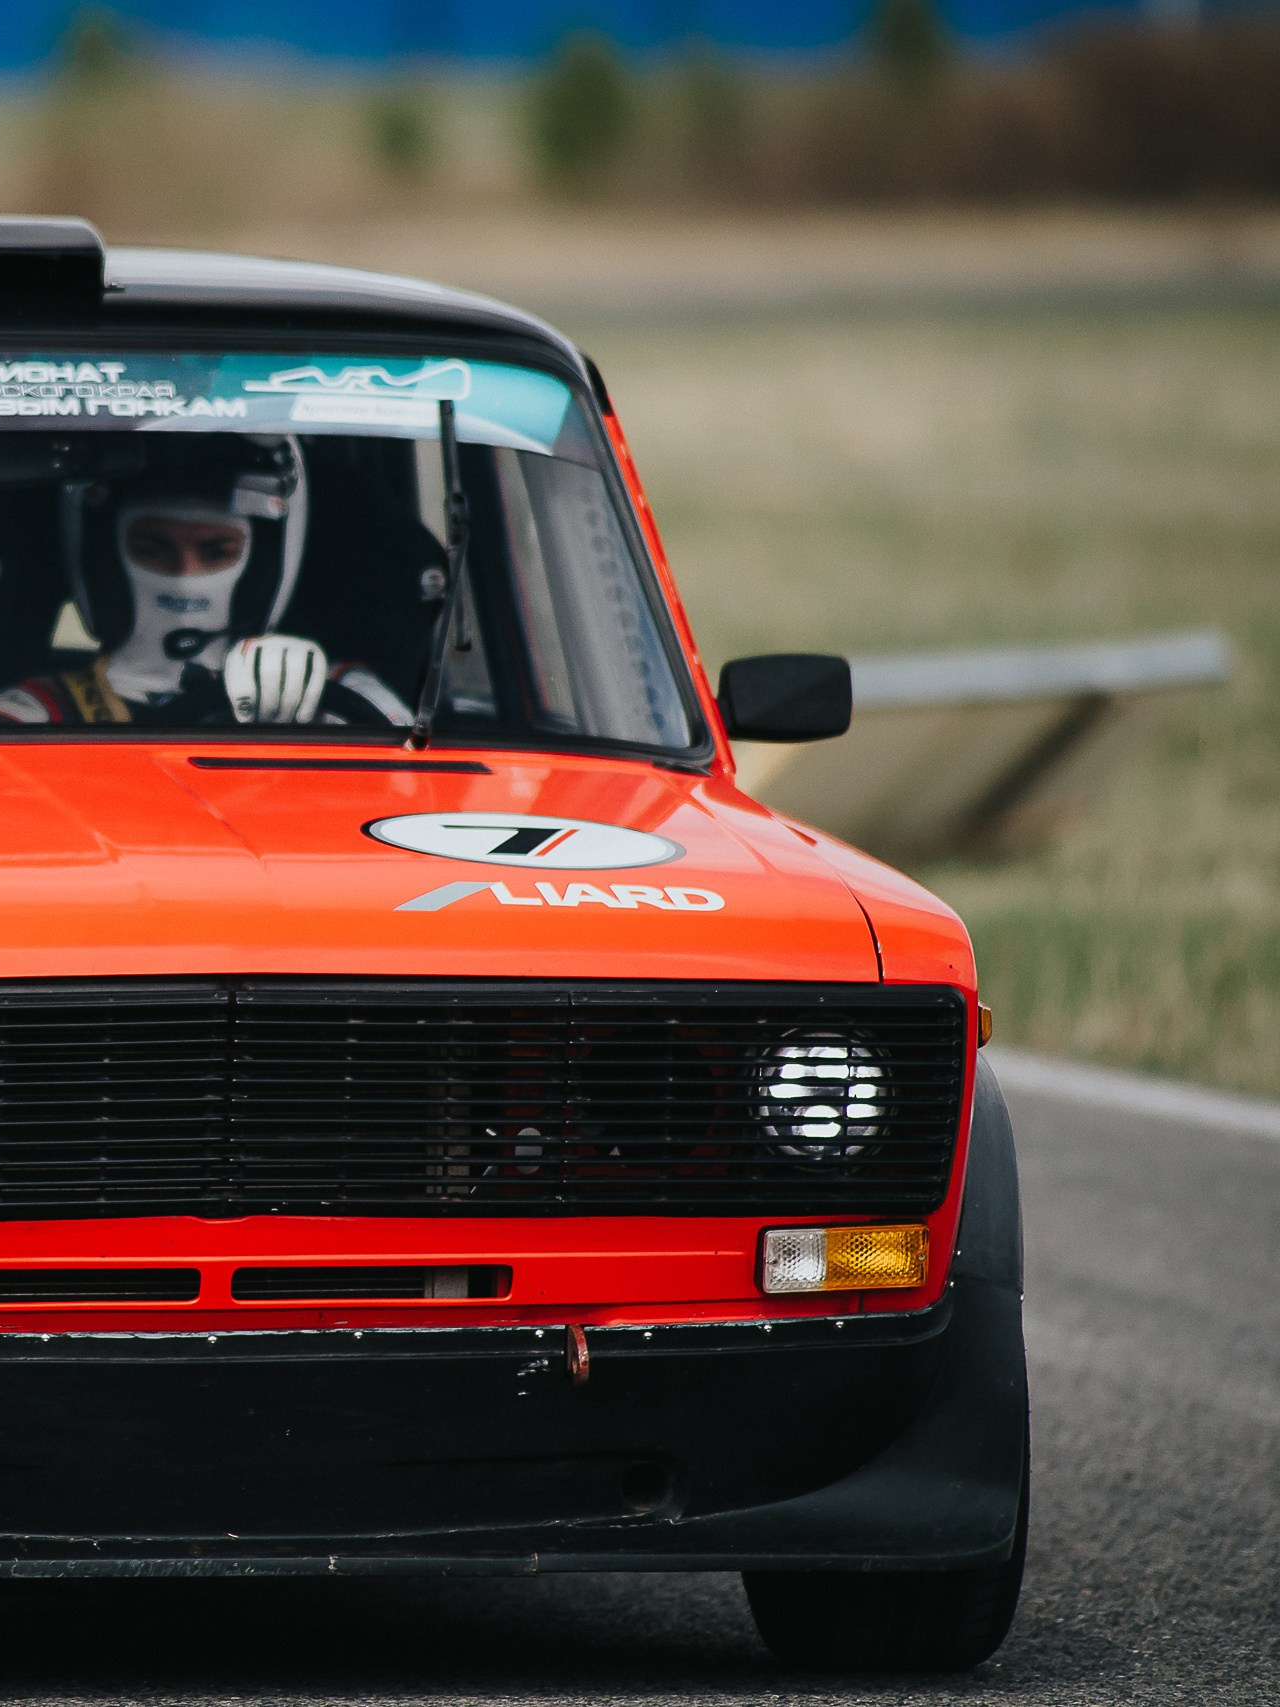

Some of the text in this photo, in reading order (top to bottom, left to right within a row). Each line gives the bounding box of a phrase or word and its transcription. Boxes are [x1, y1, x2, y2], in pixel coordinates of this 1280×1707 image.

[99, 382, 175, 398] КРАЯ
[88, 397, 246, 417] ГОНКАМ
[441, 823, 564, 856] 7
[488, 881, 725, 912] LIARD
